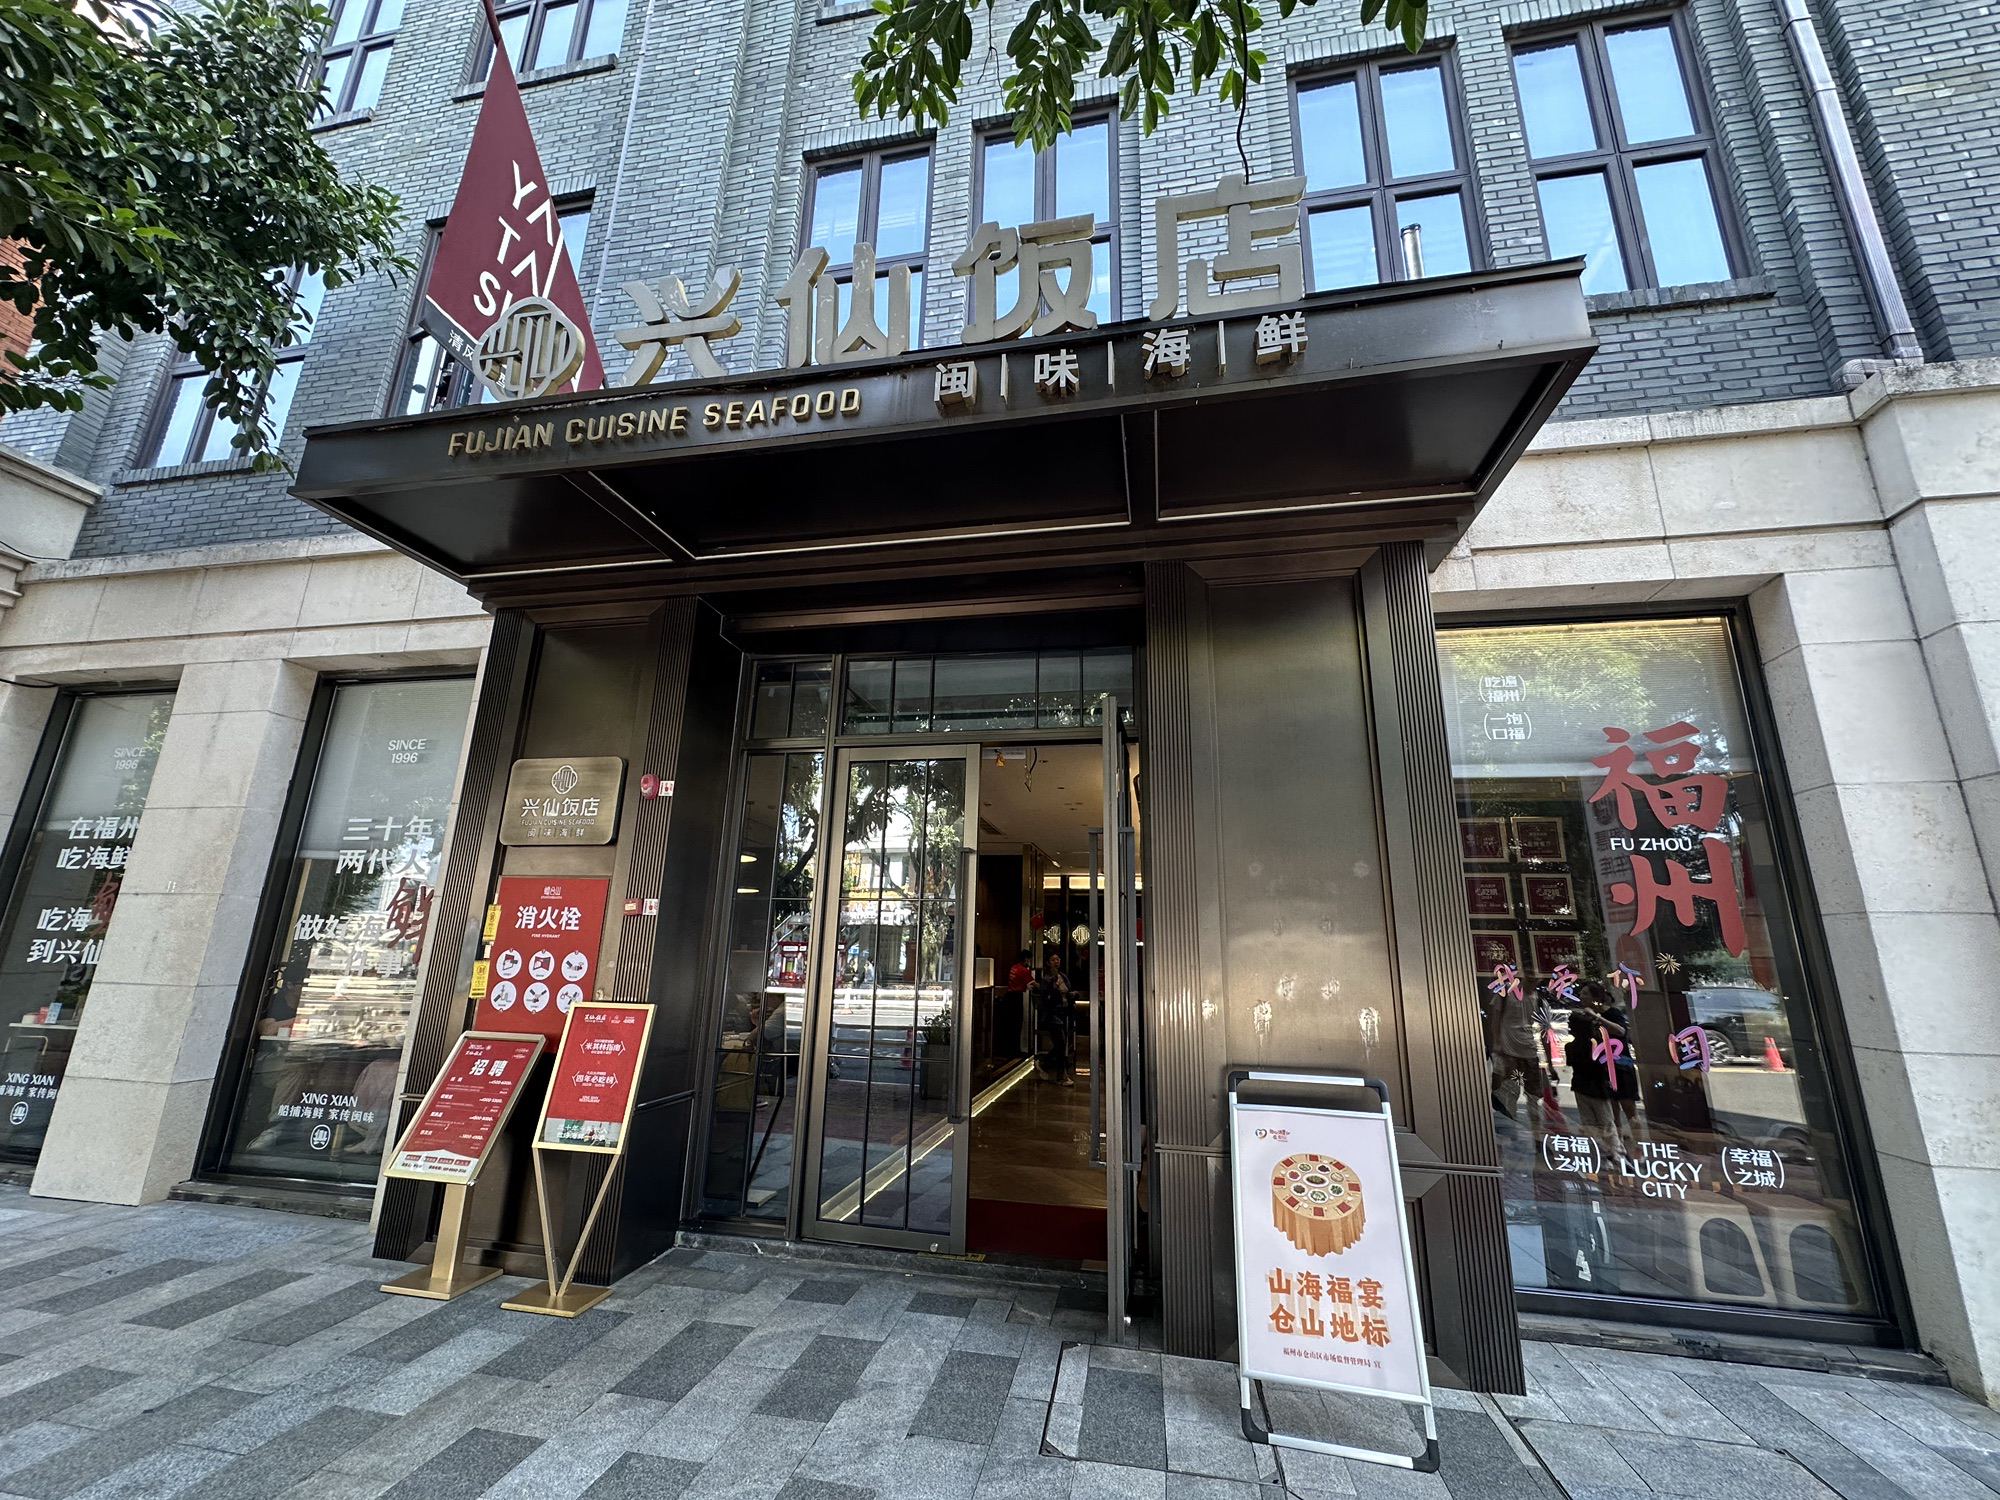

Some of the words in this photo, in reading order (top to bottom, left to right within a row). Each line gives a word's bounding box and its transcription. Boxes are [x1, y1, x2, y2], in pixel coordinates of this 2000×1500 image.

[614, 173, 1308, 391] 兴仙饭店
[447, 421, 554, 457] FUJIAN
[564, 406, 689, 445] CUISINE
[702, 388, 861, 428] SEAFOOD
[1487, 690, 1520, 702] 福州
[1492, 728, 1525, 740] 口福
[114, 747, 147, 758] SINCE
[388, 738, 428, 751] SINCE
[115, 759, 139, 770] 1996
[391, 752, 419, 764] 1996
[521, 798, 600, 817] 兴仙饭店
[343, 815, 434, 842] 三十年
[1610, 837, 1635, 851] FU
[1638, 837, 1693, 851] ZHOU
[335, 848, 427, 875] 两代人
[515, 905, 582, 931] 消火栓
[26, 937, 104, 965] 到兴仙
[1487, 961, 1645, 1009] 我爱你
[1591, 1025, 1710, 1092] 中国
[5, 1072, 30, 1084] XING
[30, 1074, 55, 1086] XIAN
[300, 1092, 328, 1105] XING
[330, 1094, 358, 1108] XIAN
[278, 1104, 324, 1119] 船捕海鲜
[328, 1108, 375, 1123] 家传闽味
[1551, 1134, 1591, 1154] 有福
[1637, 1141, 1680, 1160] THE
[1554, 1154, 1593, 1174] 之州
[1729, 1148, 1773, 1168] 幸福
[1620, 1158, 1703, 1183] LUCKY
[1734, 1168, 1778, 1189] 之城
[1641, 1180, 1688, 1199] CITY
[1268, 1267, 1384, 1310] 山海福宴
[1269, 1303, 1391, 1348] 仓山地标
